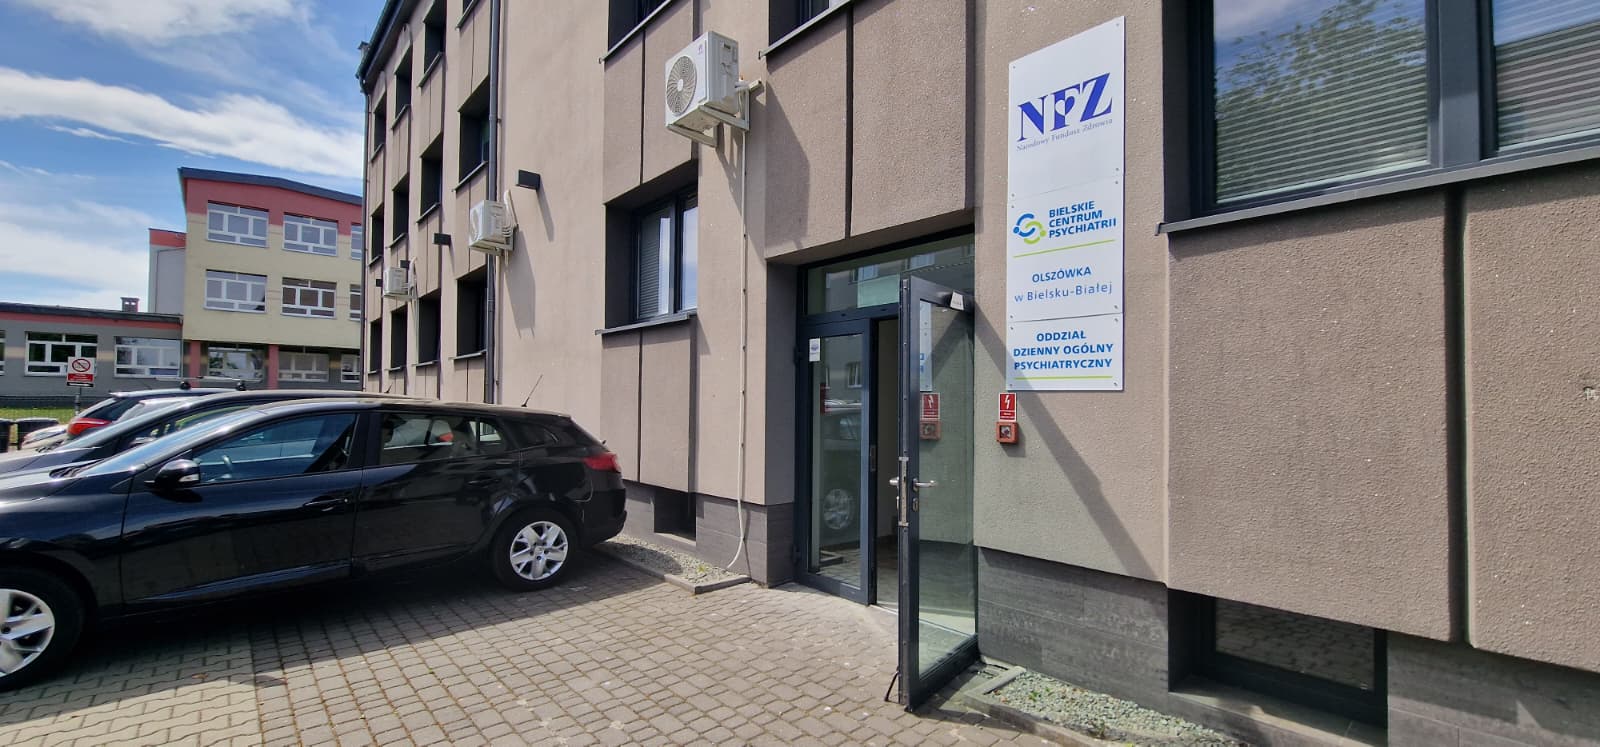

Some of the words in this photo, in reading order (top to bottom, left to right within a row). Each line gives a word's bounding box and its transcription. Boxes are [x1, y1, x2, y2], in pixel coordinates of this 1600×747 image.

[1017, 72, 1113, 142] NFZ
[1016, 137, 1050, 152] Narodowy
[1051, 128, 1081, 142] Fundusz
[1082, 118, 1113, 135] Zdrowia
[1049, 200, 1095, 218] BIELSKIE
[1049, 209, 1103, 228] CENTRUM
[1049, 218, 1117, 238] PSYCHIATRII
[1032, 266, 1092, 283] OLSZÓWKA
[1014, 294, 1024, 302] w
[1027, 282, 1113, 301] Bielsku-Białej
[1036, 330, 1086, 342] ODDZIAŁ
[1013, 345, 1060, 357] DZIENNY
[1063, 342, 1114, 355] OGÓLNY
[1014, 358, 1113, 370] PSYCHIATRYCZNY
